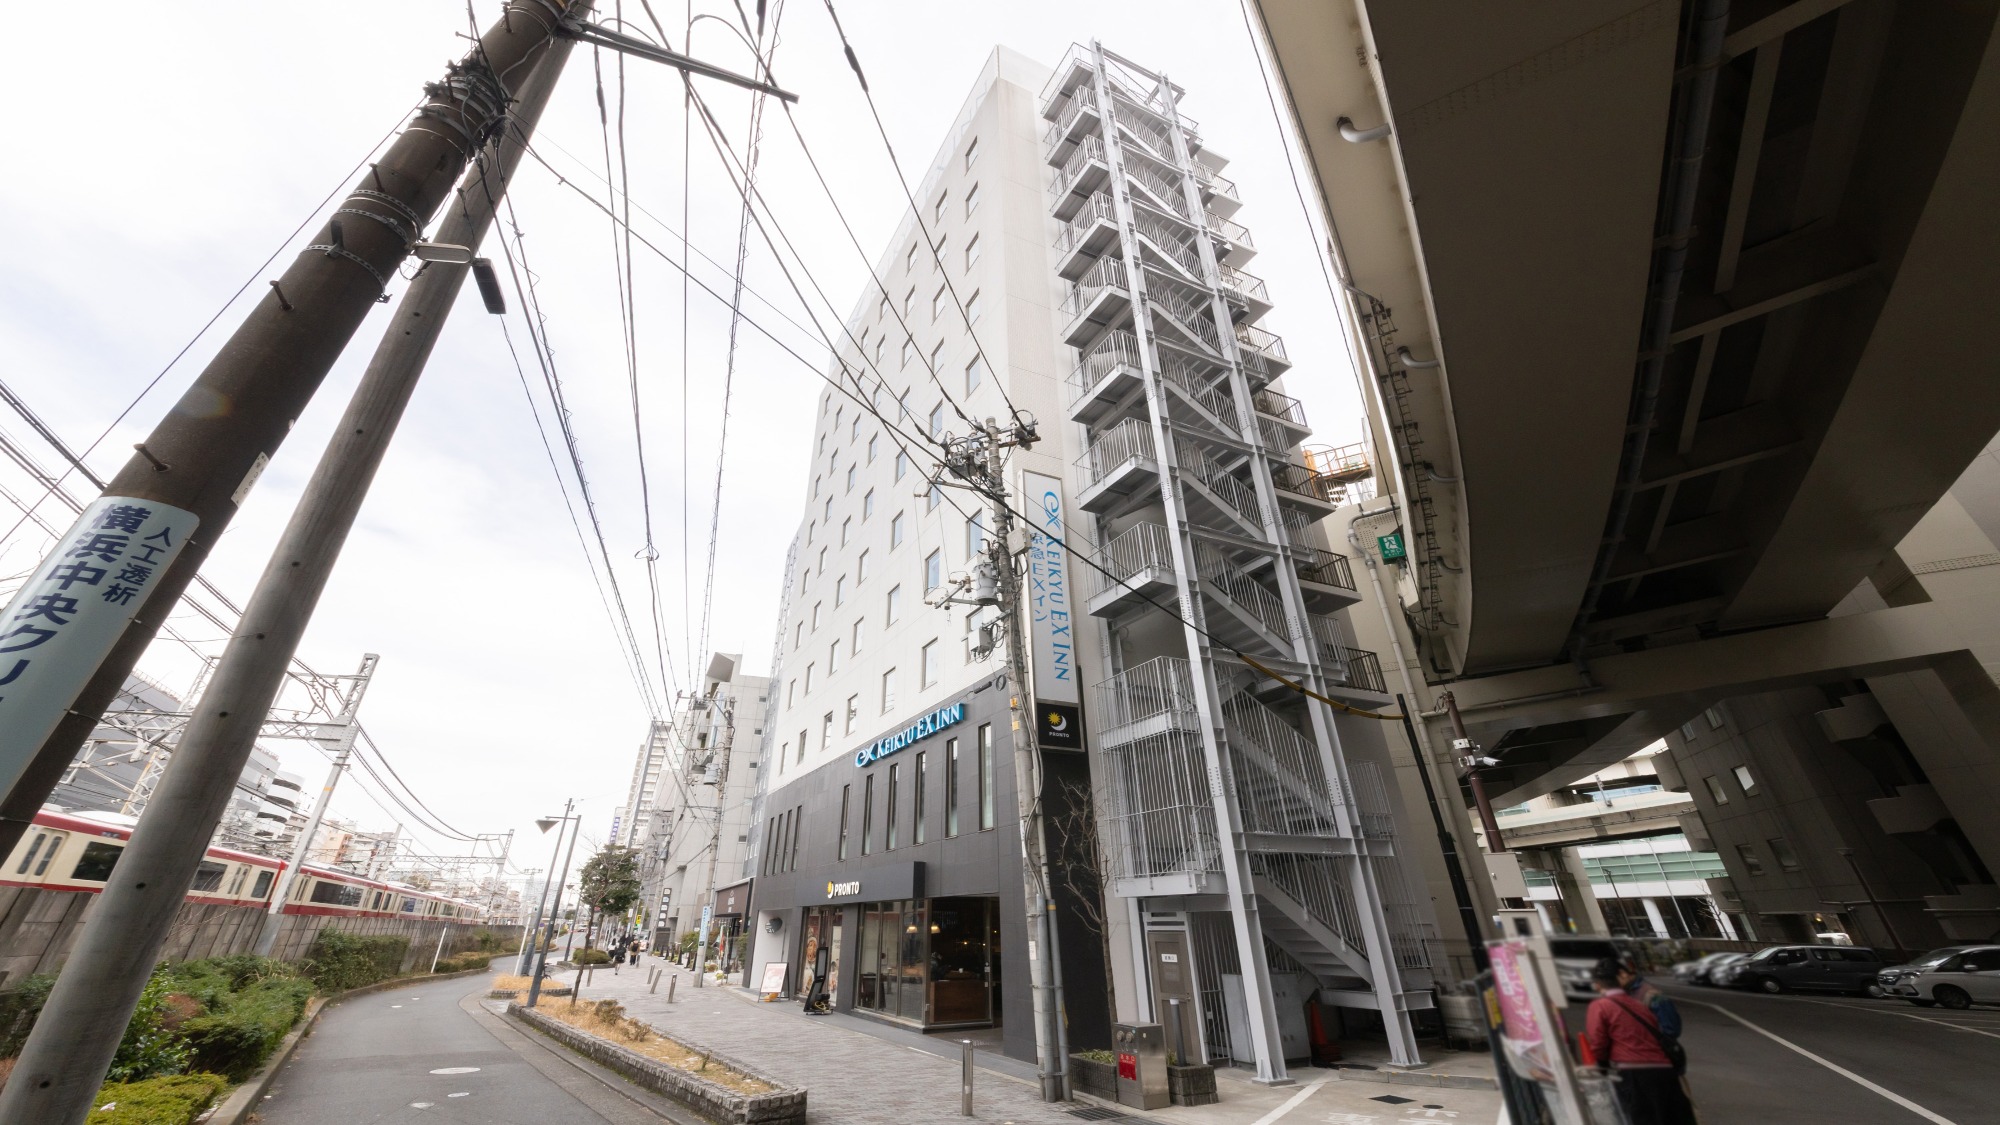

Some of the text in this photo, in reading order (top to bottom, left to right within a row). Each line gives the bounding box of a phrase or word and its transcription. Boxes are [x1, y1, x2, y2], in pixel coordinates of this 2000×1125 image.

[102, 526, 171, 606] 人工透析
[1030, 532, 1048, 622] 京急EXイン
[1046, 536, 1063, 604] KEIKYU
[1051, 609, 1070, 638] EX
[1053, 642, 1070, 682] INN
[877, 725, 917, 760] KEIKYU
[916, 712, 936, 740] EX
[936, 703, 964, 731] INN
[834, 881, 860, 897] PRONTO
